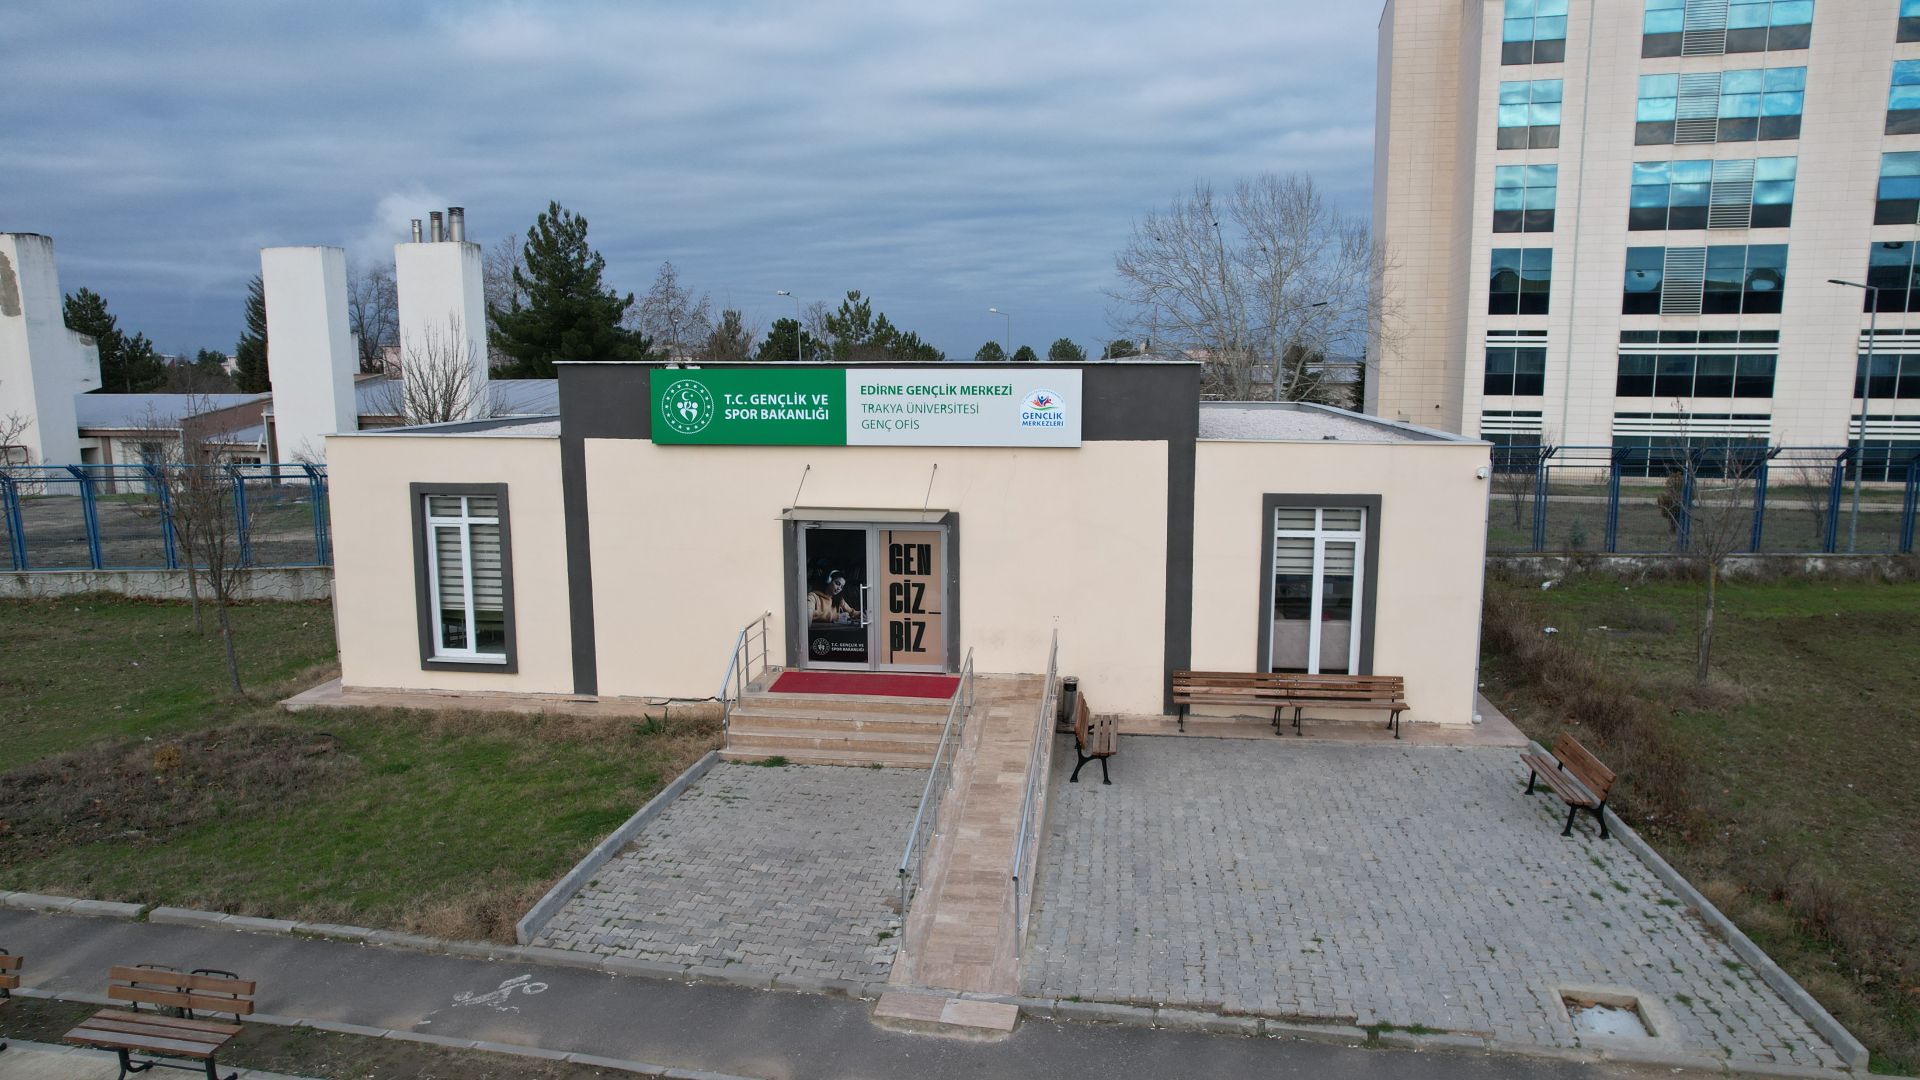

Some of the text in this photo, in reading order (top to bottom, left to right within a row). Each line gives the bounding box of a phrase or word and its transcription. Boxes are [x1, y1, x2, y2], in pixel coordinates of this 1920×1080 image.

[860, 383, 903, 396] EDİRNE
[906, 383, 957, 398] GENÇLİK
[960, 383, 1013, 396] MERKEZİ
[724, 391, 829, 408] T.C. GENÇLİK VE
[725, 406, 829, 420] SPOR BAKANLIĞI
[861, 401, 979, 414] TRAKYA ÜNİVERSİTESİ
[861, 418, 920, 432] GENÇ OFİS
[889, 543, 931, 575] GEN
[889, 617, 926, 653] BİZ
